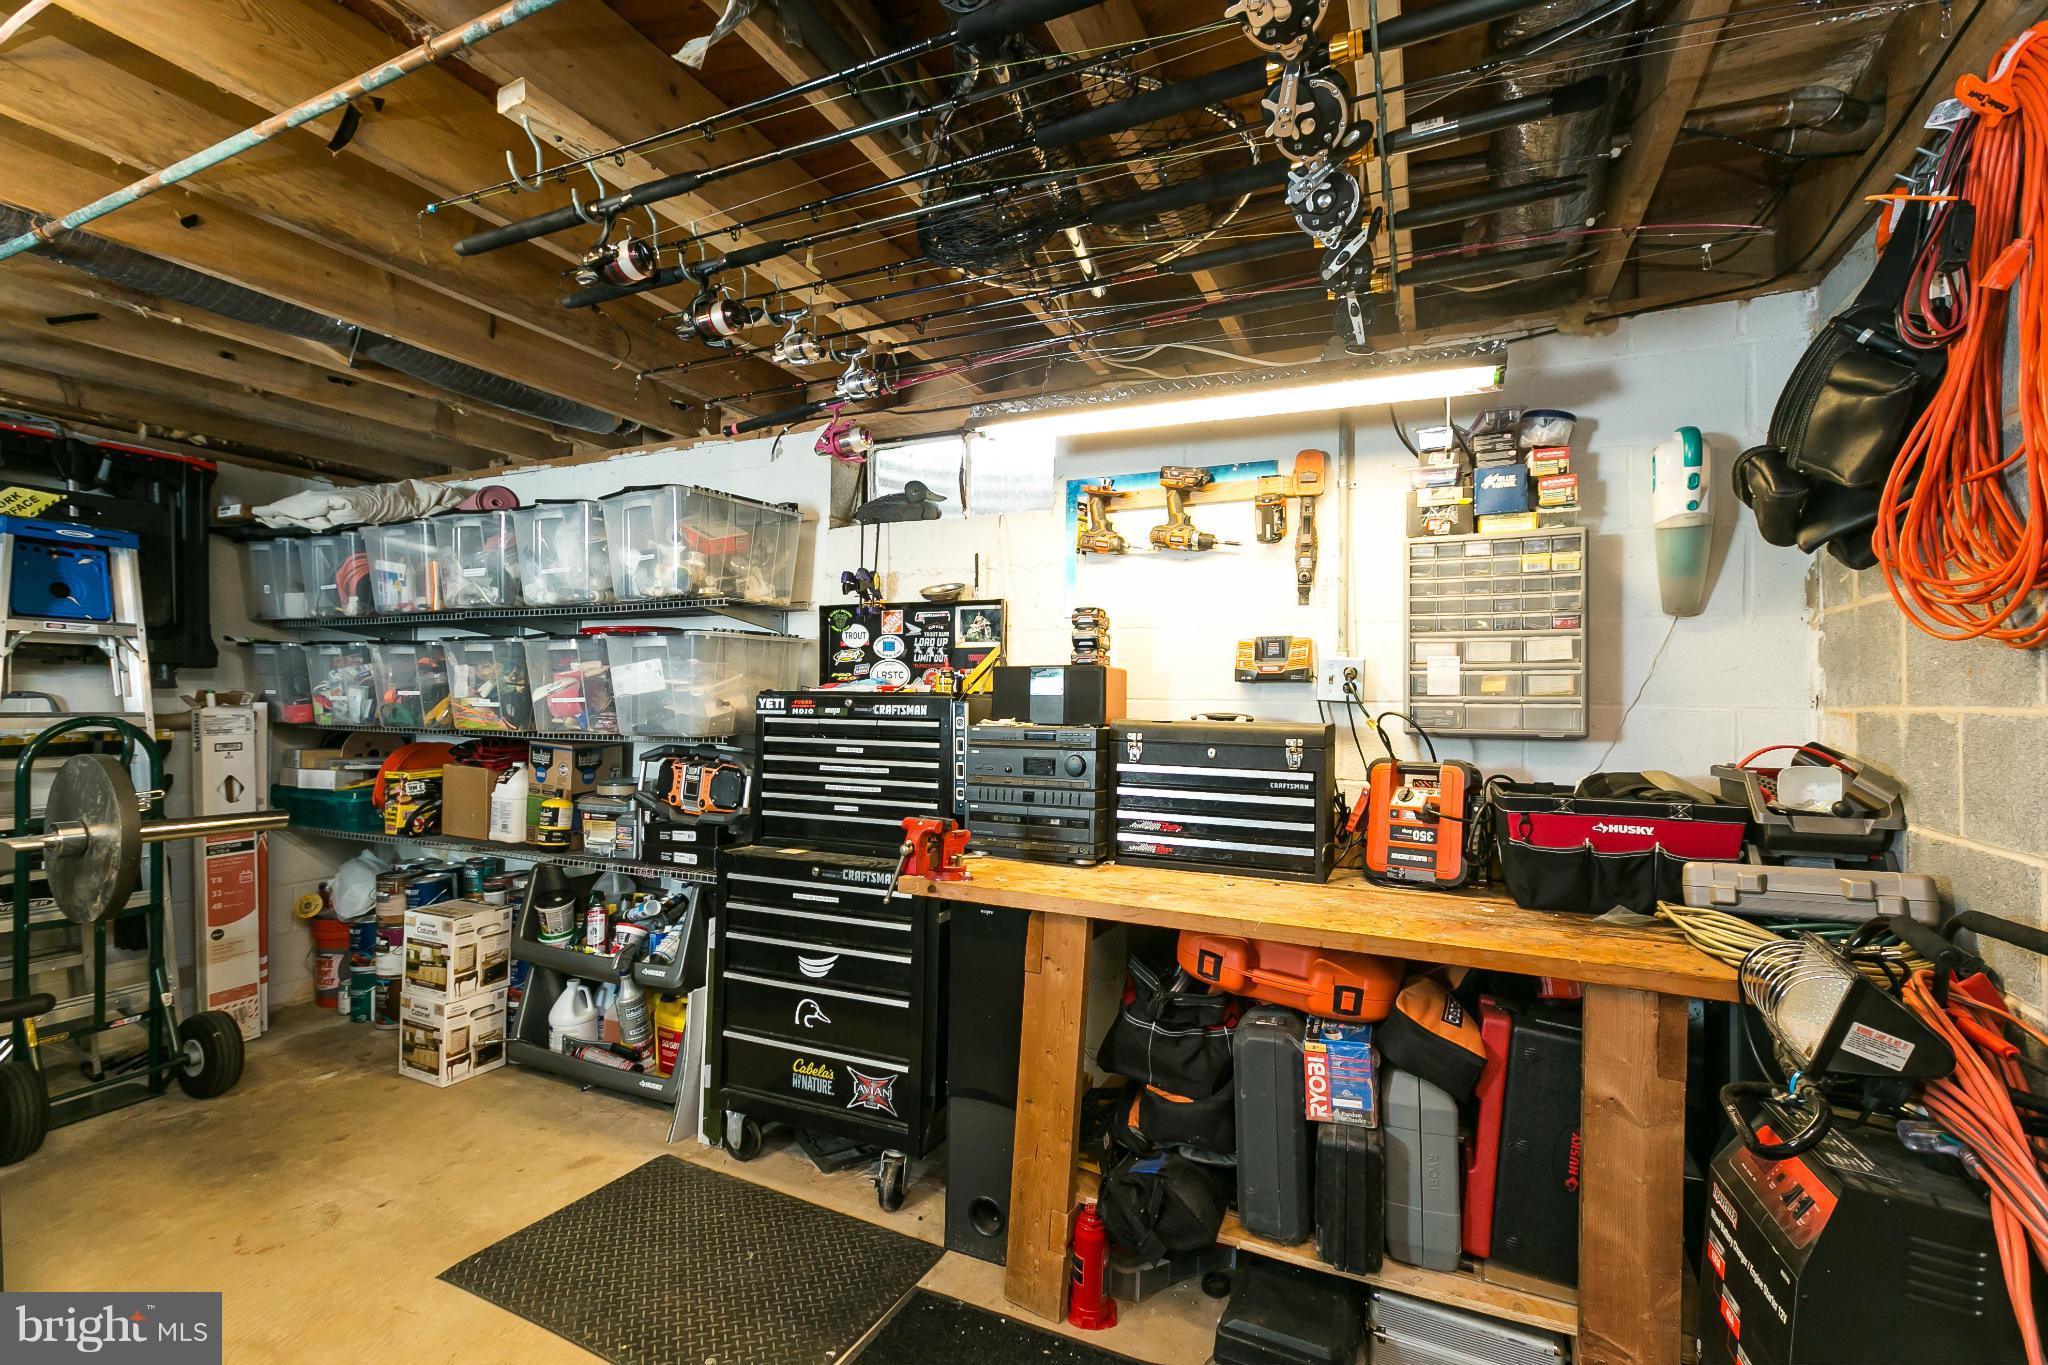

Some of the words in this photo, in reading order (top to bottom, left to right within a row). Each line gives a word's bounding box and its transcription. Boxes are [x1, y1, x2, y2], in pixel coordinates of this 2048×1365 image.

[845, 632, 867, 640] TROUT
[937, 637, 948, 647] UP
[758, 698, 785, 709] YETI
[873, 704, 928, 716] CRAFTSMAN
[1270, 782, 1309, 790] CRAFTSMAN
[1412, 829, 1435, 842] 350
[1608, 824, 1655, 836] HUSKY
[793, 1058, 835, 1080] Cabela's
[856, 1084, 890, 1098] AVIAN
[1307, 1056, 1329, 1117] RYOBI
